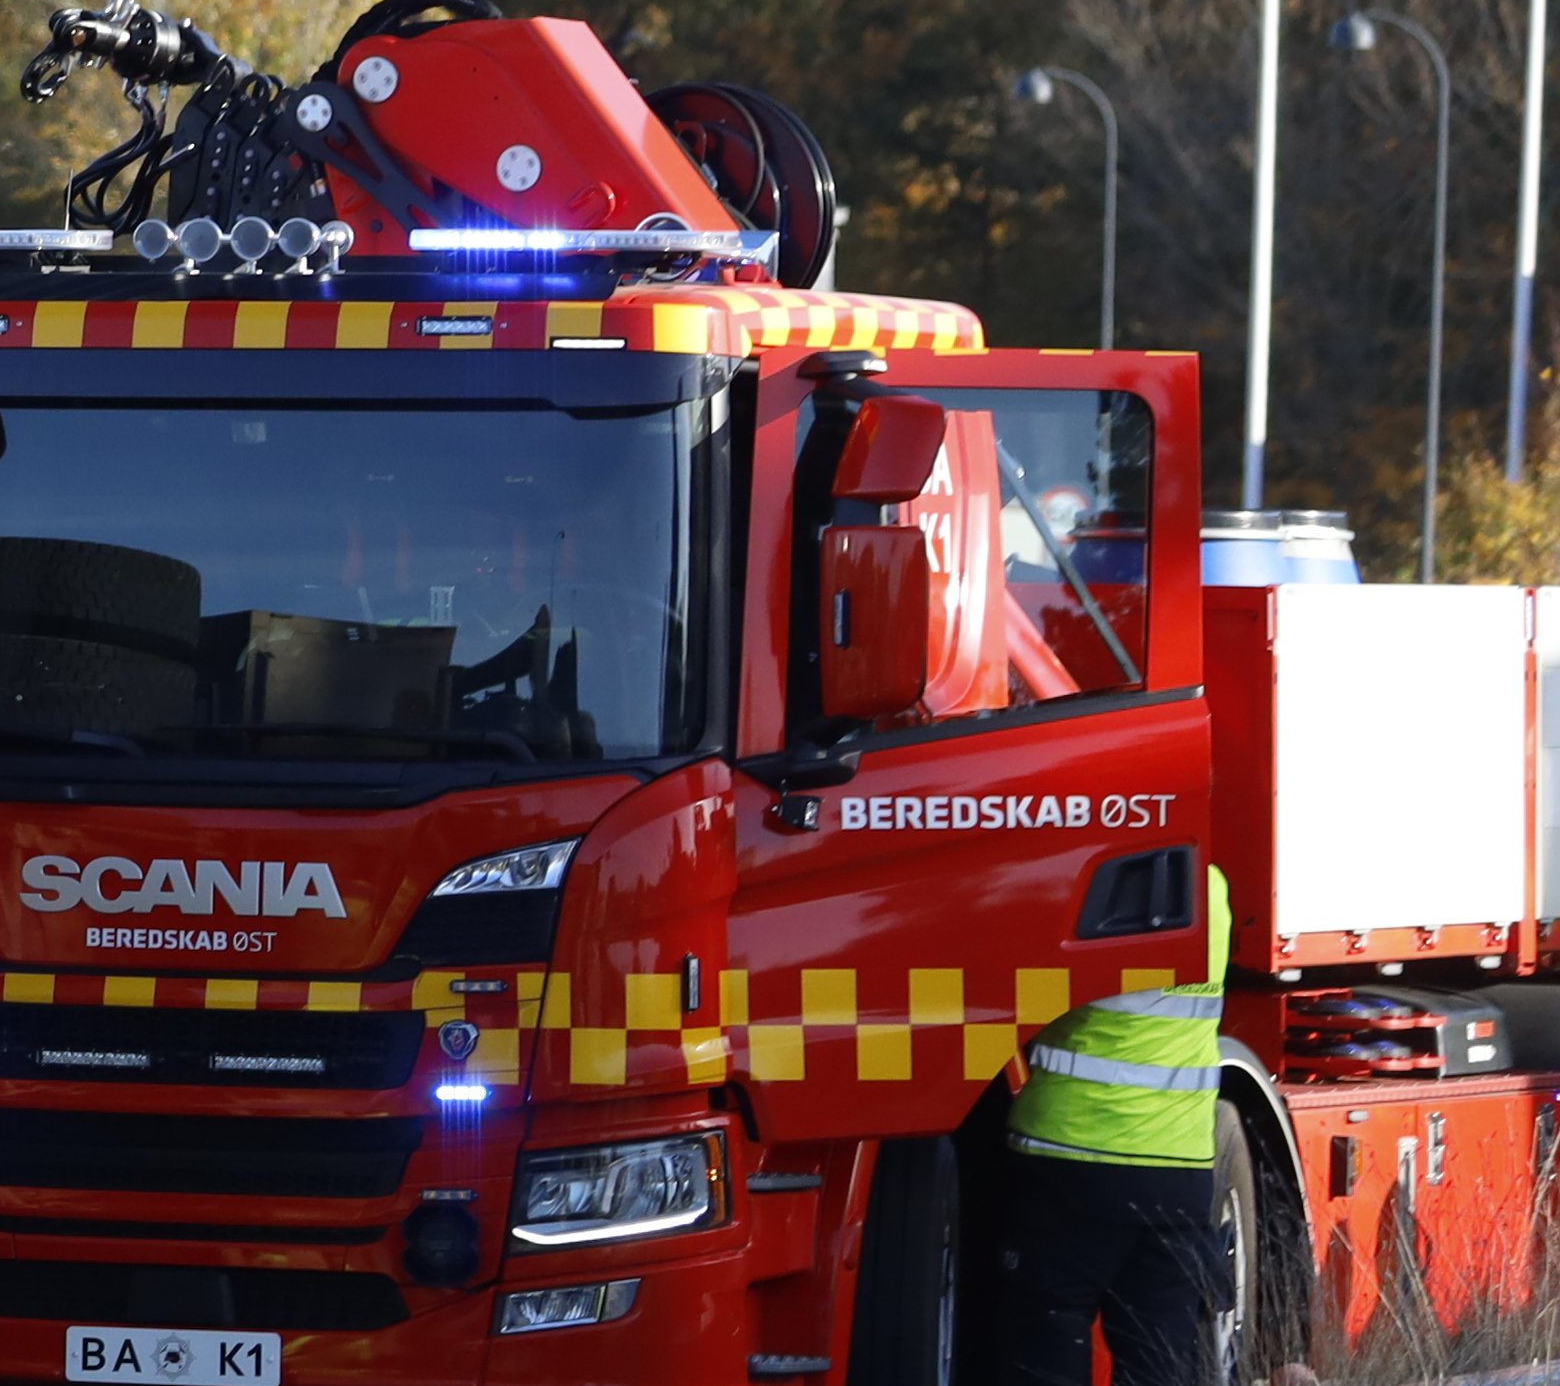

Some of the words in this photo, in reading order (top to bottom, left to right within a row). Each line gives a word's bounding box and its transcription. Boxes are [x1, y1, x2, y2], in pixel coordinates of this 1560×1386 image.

[920, 443, 954, 496] A
[840, 795, 1092, 830] BEREDSKAB
[1100, 794, 1177, 829] ØST
[19, 854, 348, 919] SCANIA
[85, 927, 229, 951] BEREDSKAB
[232, 931, 278, 954] ØST
[81, 1337, 143, 1374] BA
[220, 1342, 263, 1378] K1
